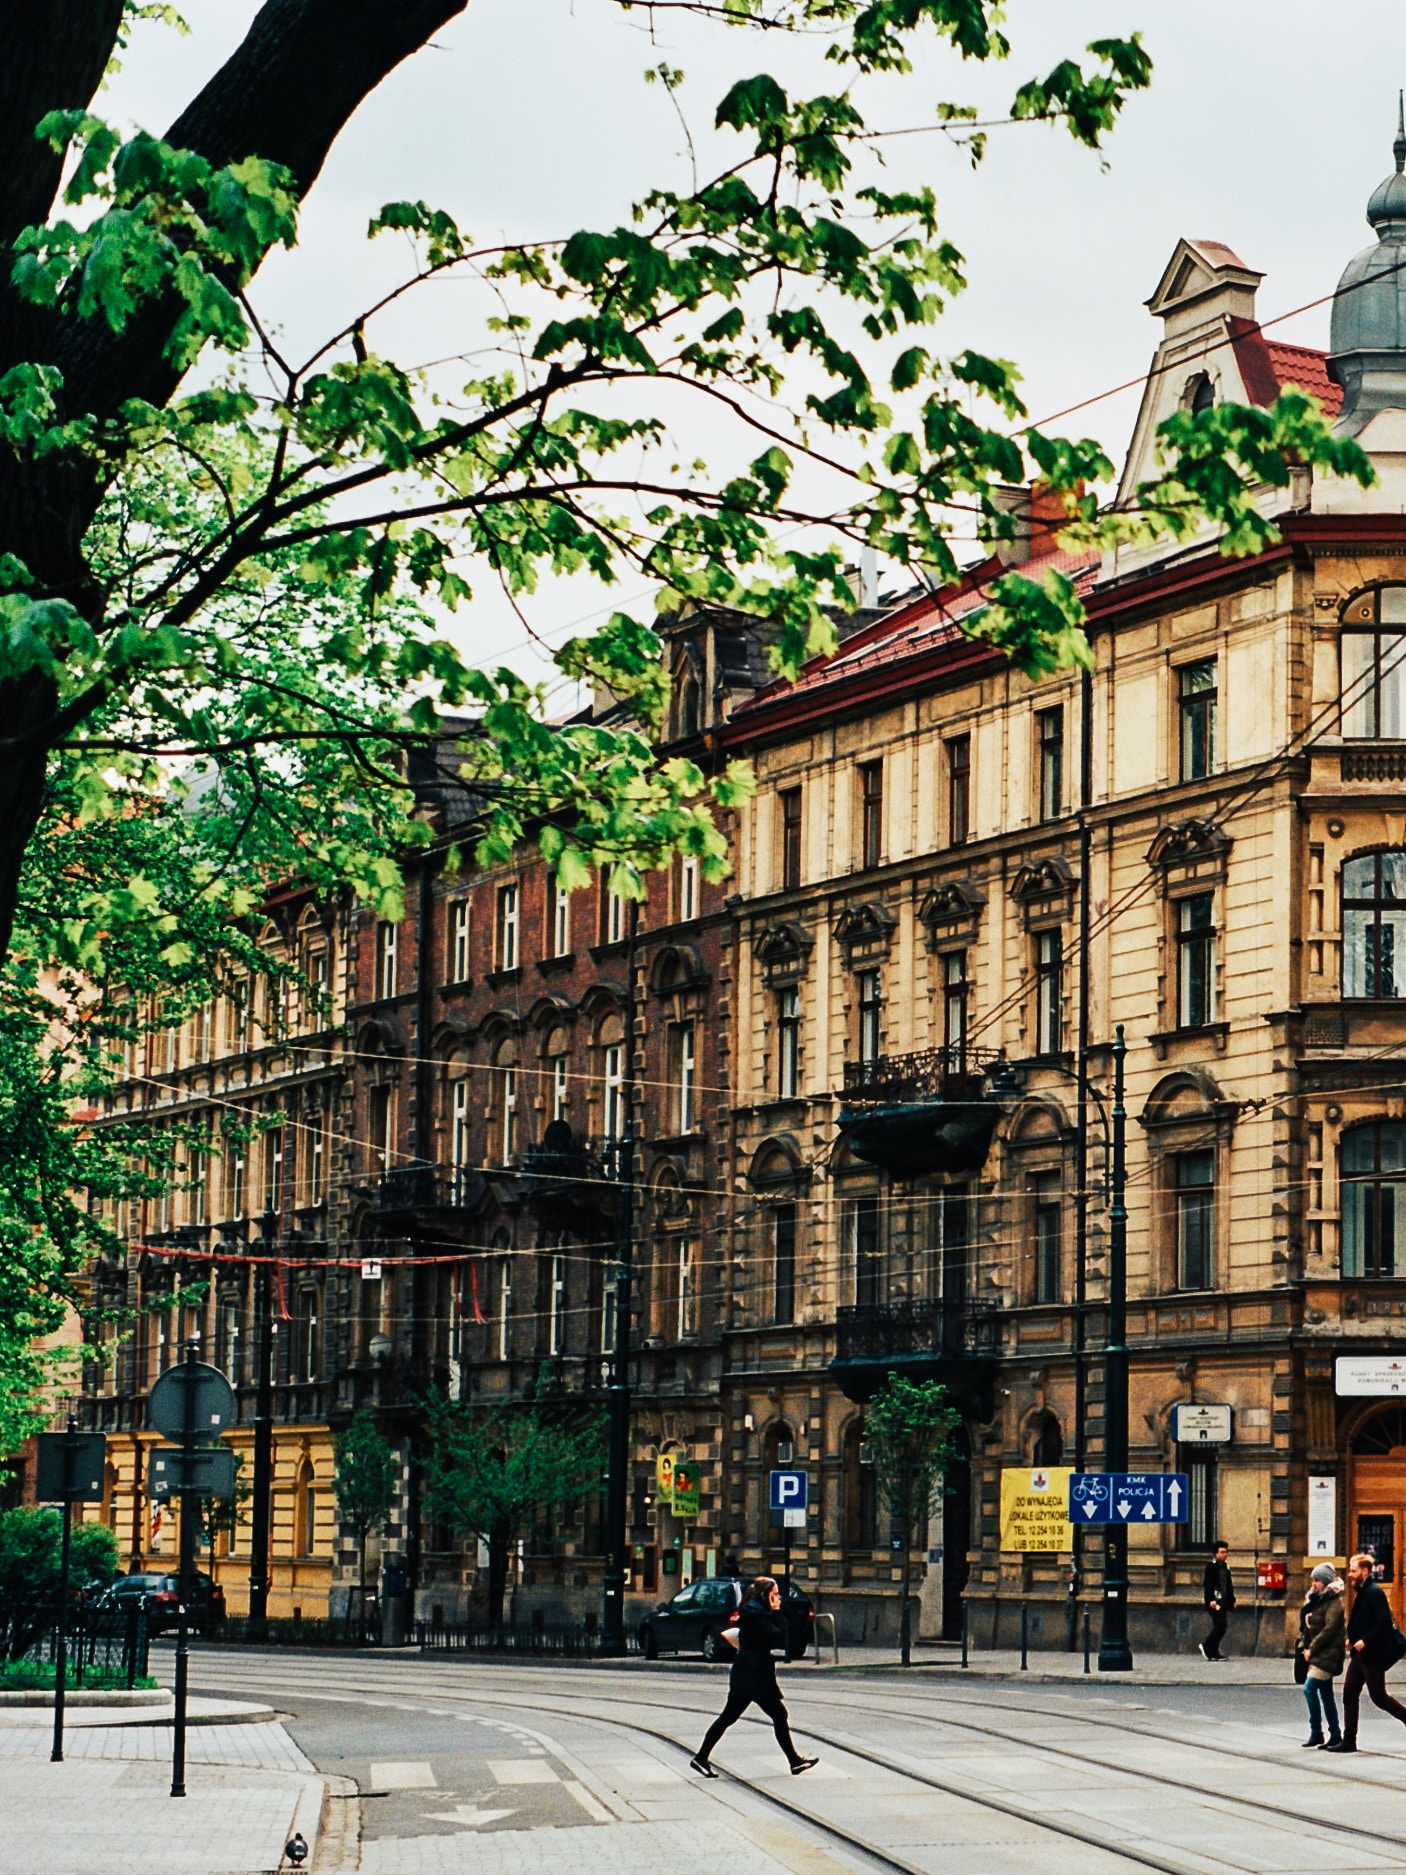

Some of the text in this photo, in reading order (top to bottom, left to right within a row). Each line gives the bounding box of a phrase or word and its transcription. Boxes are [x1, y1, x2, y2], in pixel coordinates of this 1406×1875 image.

[1126, 1476, 1146, 1484] KMK
[778, 1475, 799, 1504] P
[1118, 1487, 1155, 1496] POLICJA
[1016, 1497, 1025, 1506] DO
[1009, 1511, 1034, 1521] LOKALE
[1014, 1540, 1027, 1550] LUB
